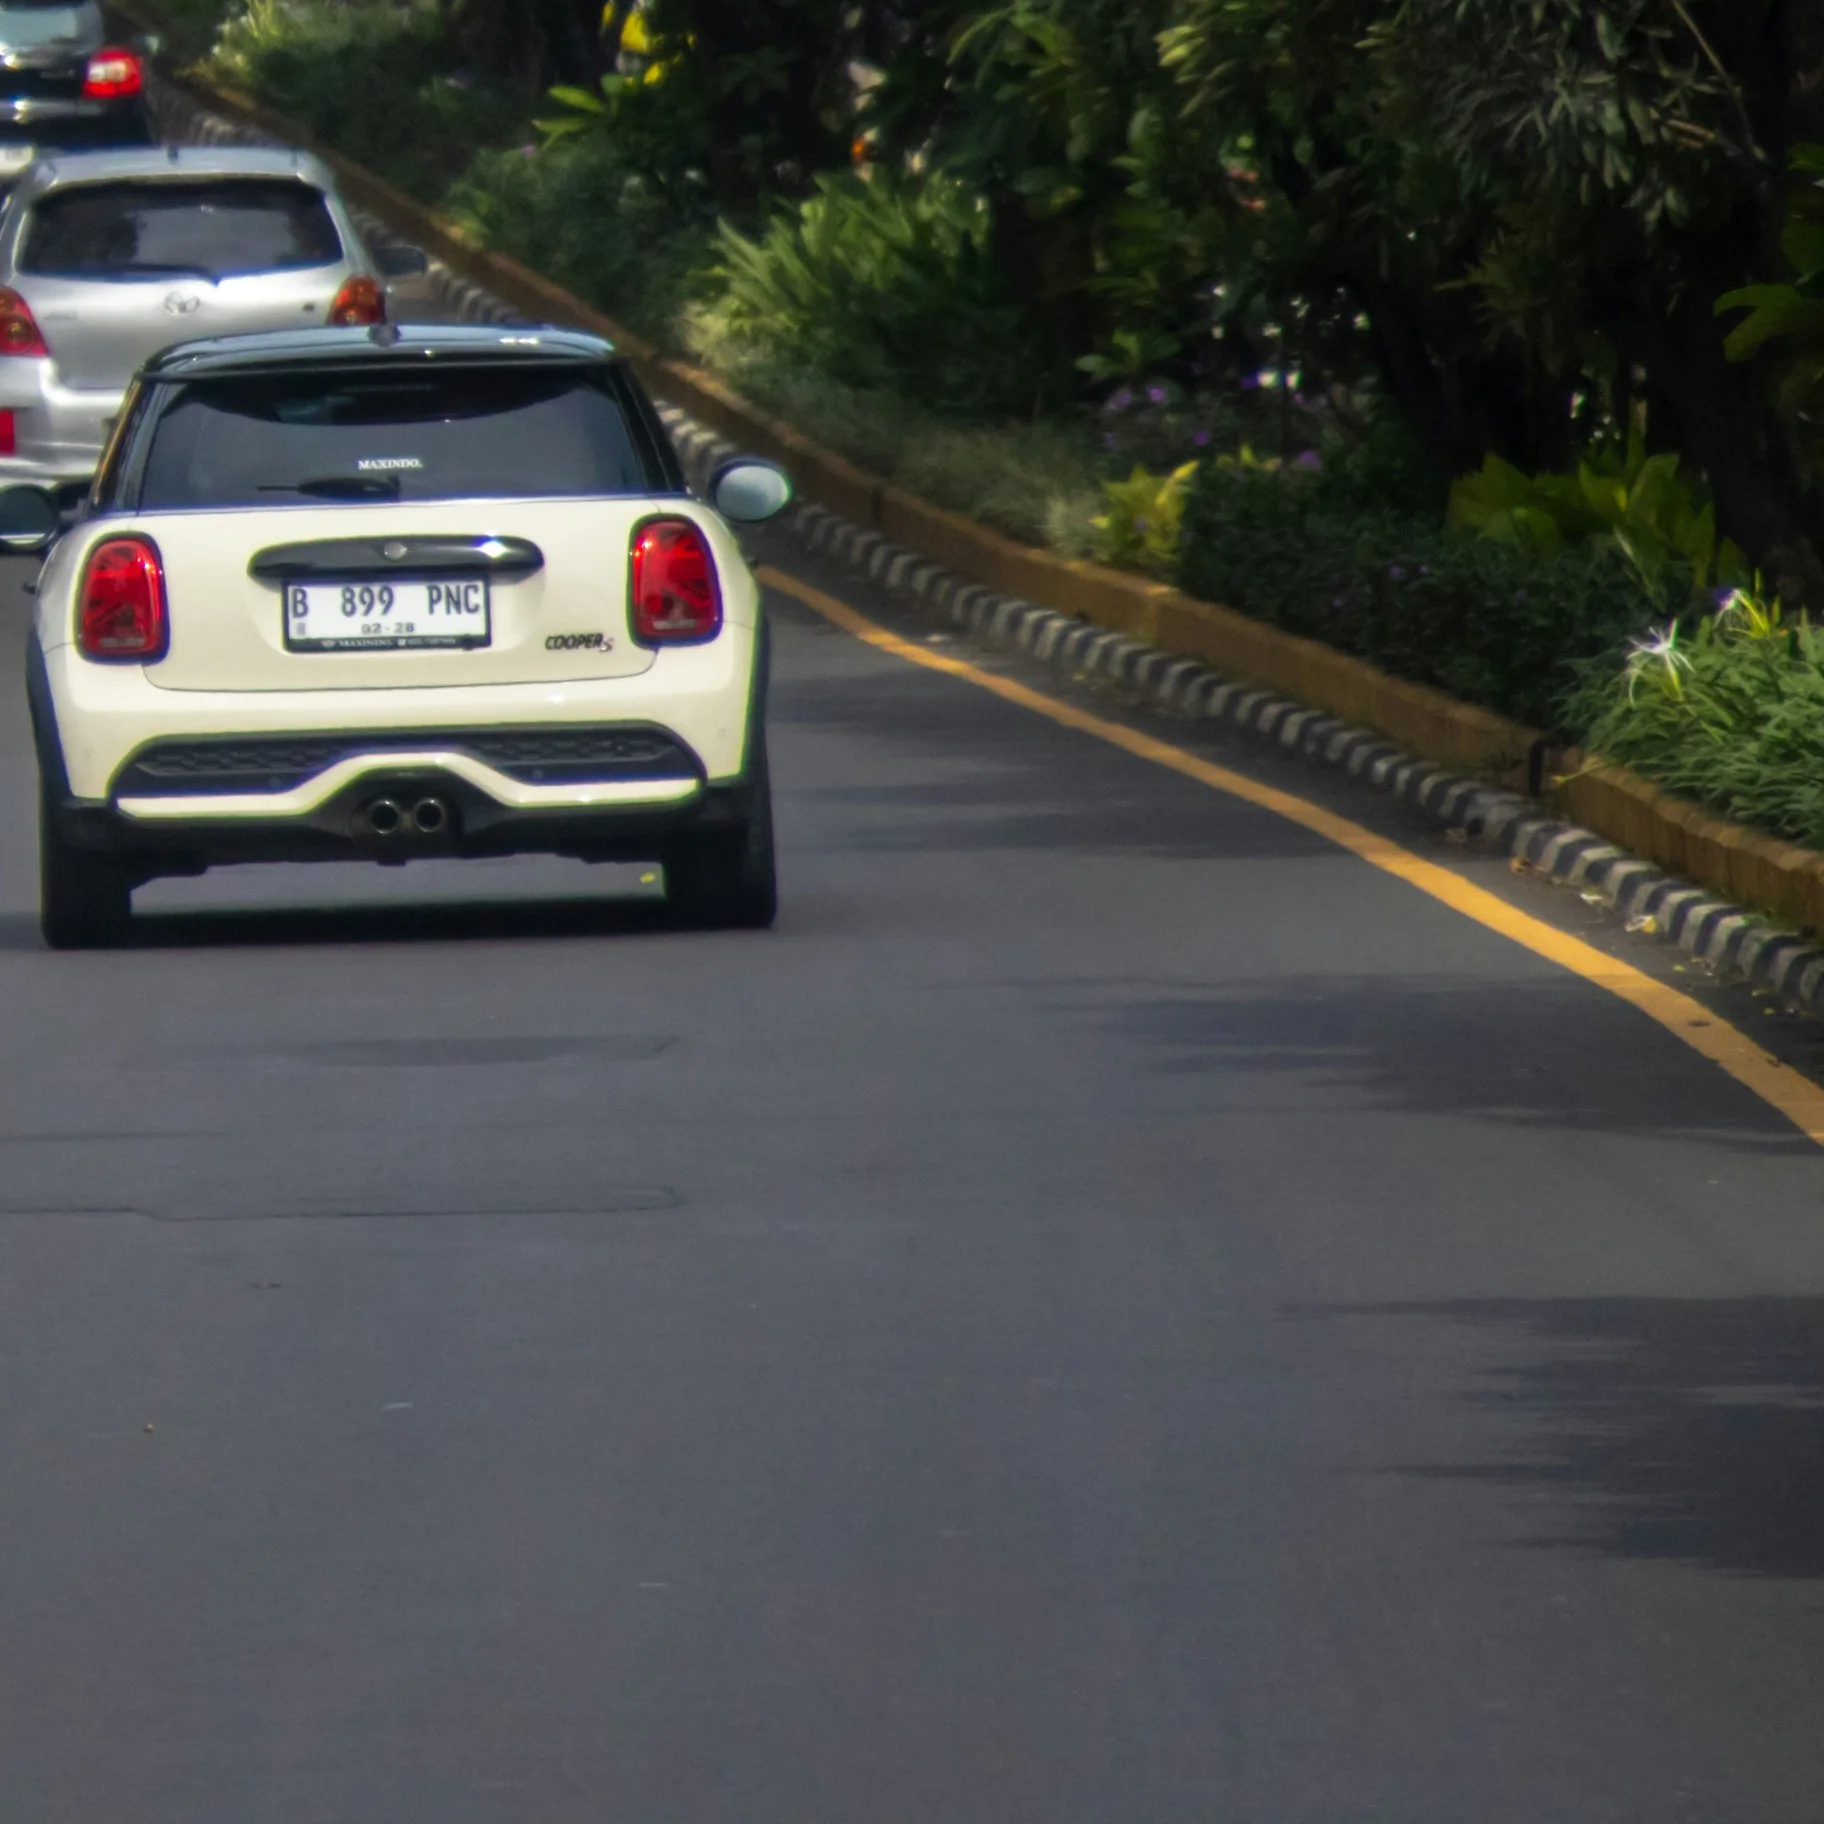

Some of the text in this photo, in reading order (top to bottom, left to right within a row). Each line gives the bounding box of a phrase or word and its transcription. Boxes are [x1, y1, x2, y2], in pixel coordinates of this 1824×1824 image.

[291, 584, 480, 619] B 899 PNC
[545, 633, 602, 651] COOPER
